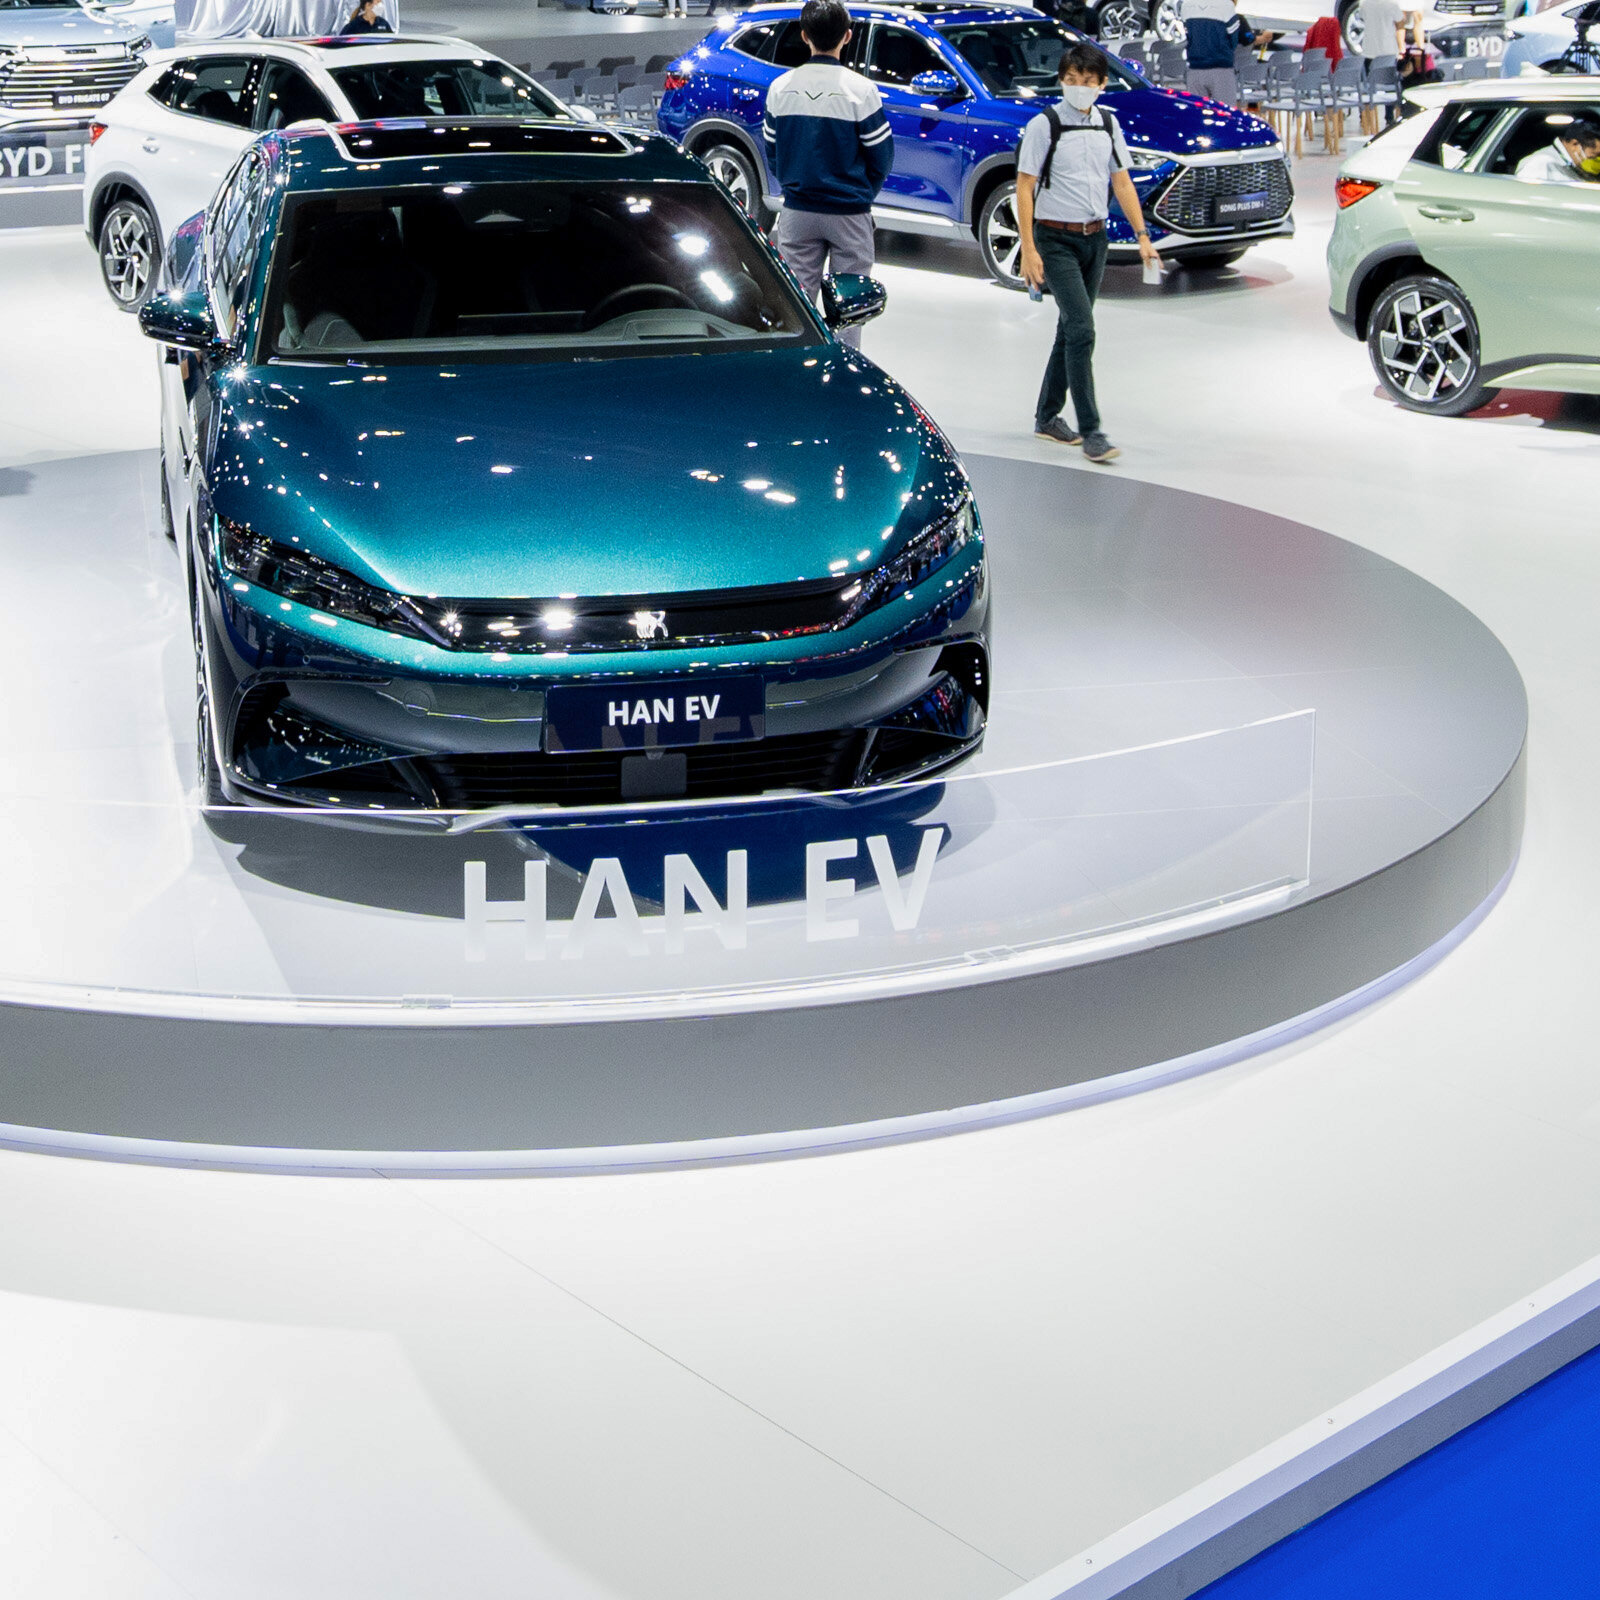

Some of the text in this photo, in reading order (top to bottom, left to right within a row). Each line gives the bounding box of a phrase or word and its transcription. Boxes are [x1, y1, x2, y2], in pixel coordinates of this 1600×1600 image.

[1466, 36, 1503, 58] BYD
[608, 694, 720, 726] HAN EV
[464, 828, 945, 962] HAN EV
